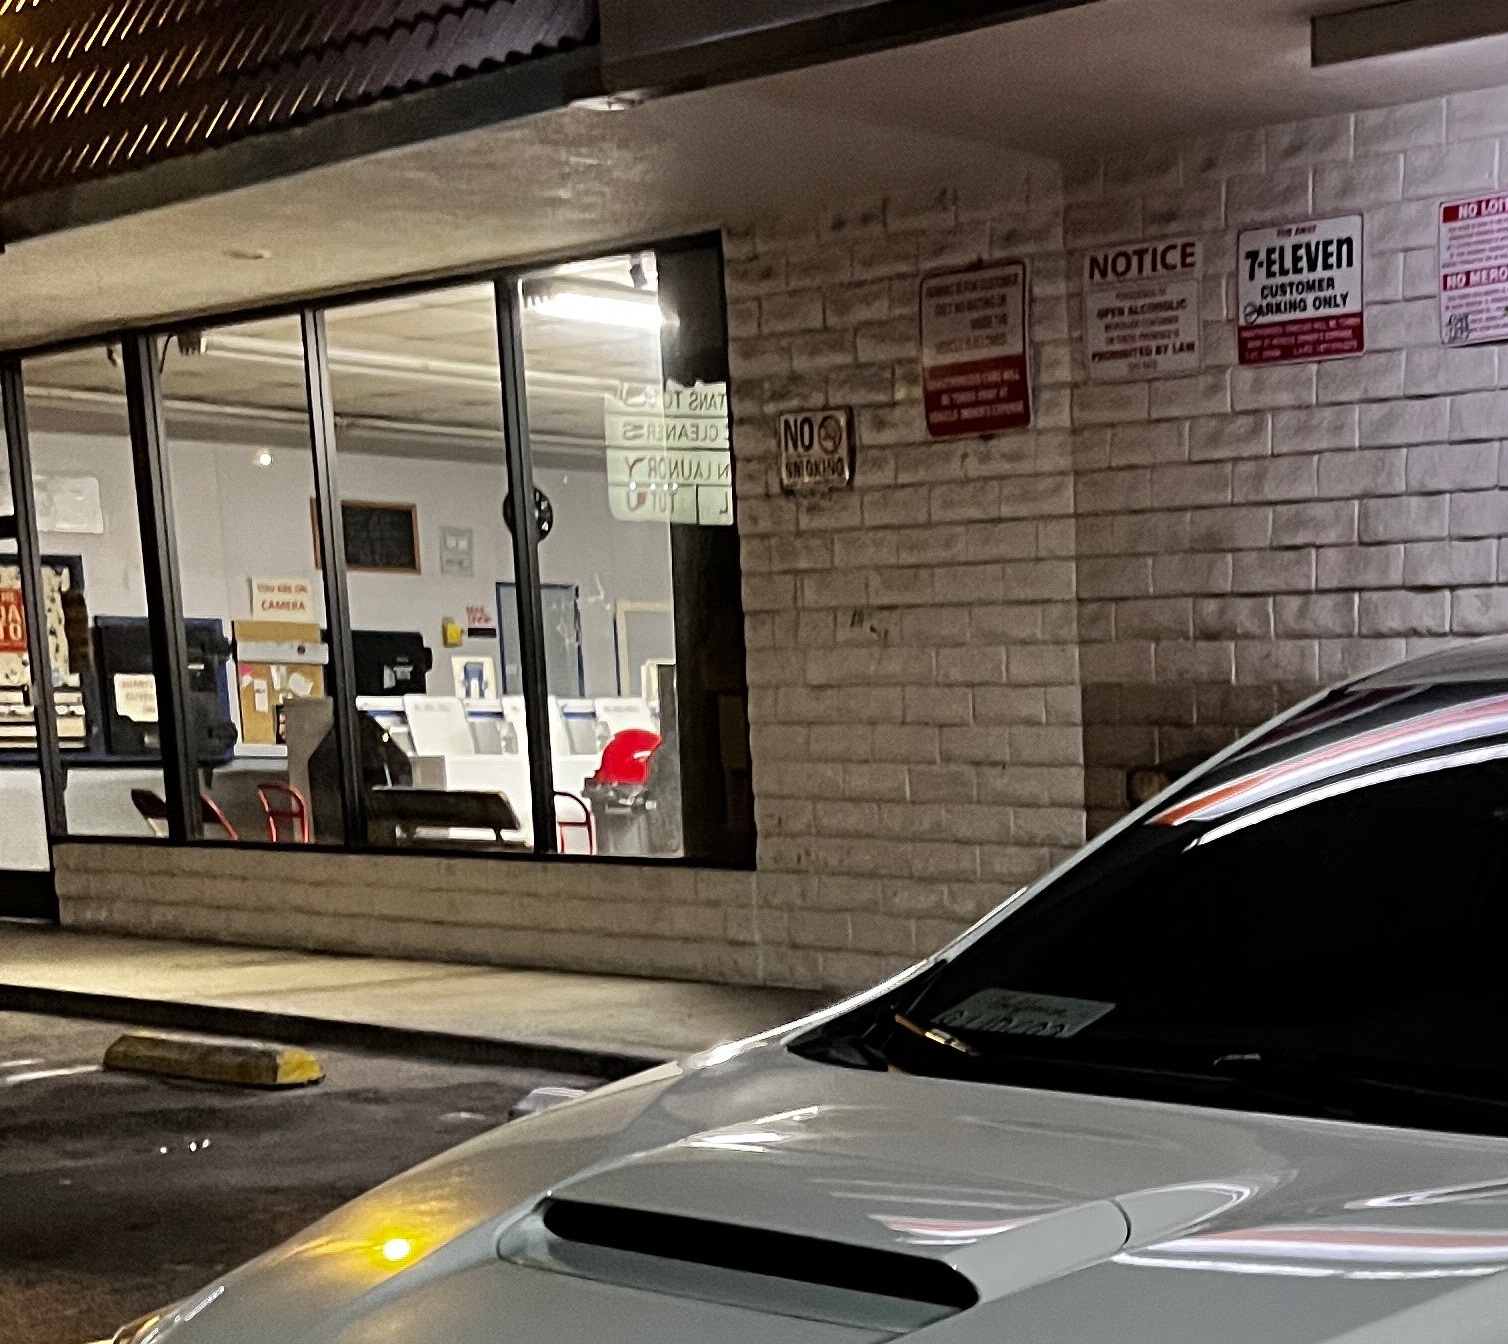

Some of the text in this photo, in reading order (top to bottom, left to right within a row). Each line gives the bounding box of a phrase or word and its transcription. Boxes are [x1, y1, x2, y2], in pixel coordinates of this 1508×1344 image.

[1458, 203, 1477, 219] NO
[1089, 242, 1196, 280] NOTICE
[1260, 277, 1335, 299] CUSTOMER
[1446, 273, 1467, 290] NO
[1312, 292, 1349, 311] ONLY
[784, 416, 815, 453] NO
[261, 600, 306, 611] CAMERA
